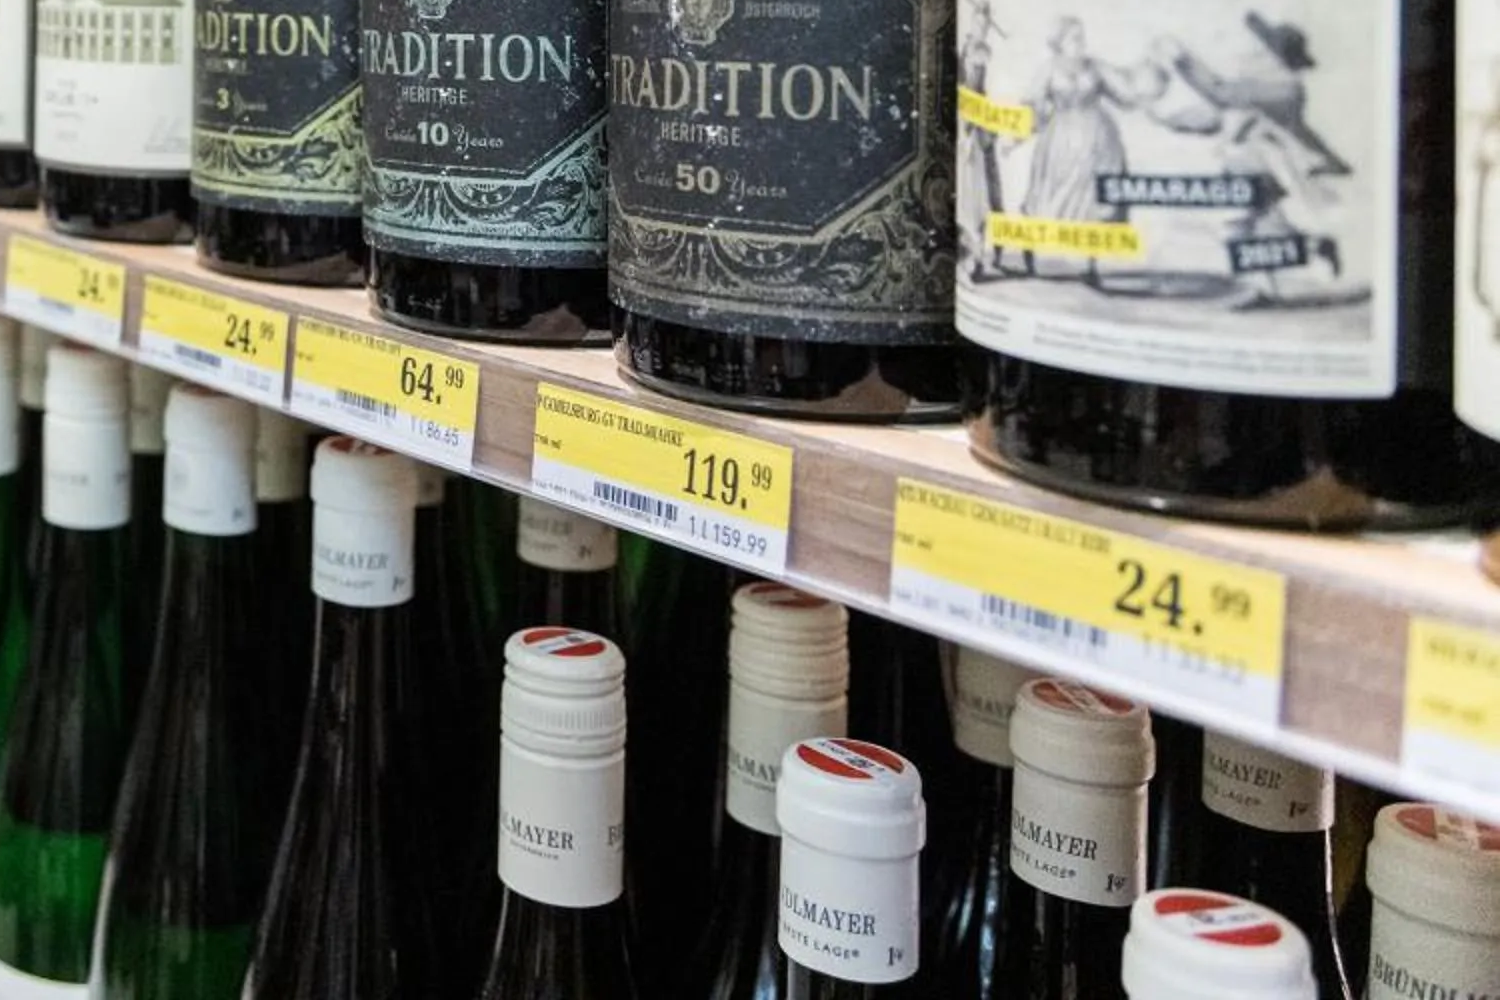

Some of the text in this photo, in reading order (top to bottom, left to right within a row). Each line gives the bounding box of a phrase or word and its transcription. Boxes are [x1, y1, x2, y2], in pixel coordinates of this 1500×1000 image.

[363, 29, 572, 83] TRADITION
[216, 87, 230, 110] 3
[611, 53, 872, 122] TRADITION
[417, 120, 449, 147] 10
[675, 162, 721, 195] 50
[1104, 177, 1253, 204] SMARAGD
